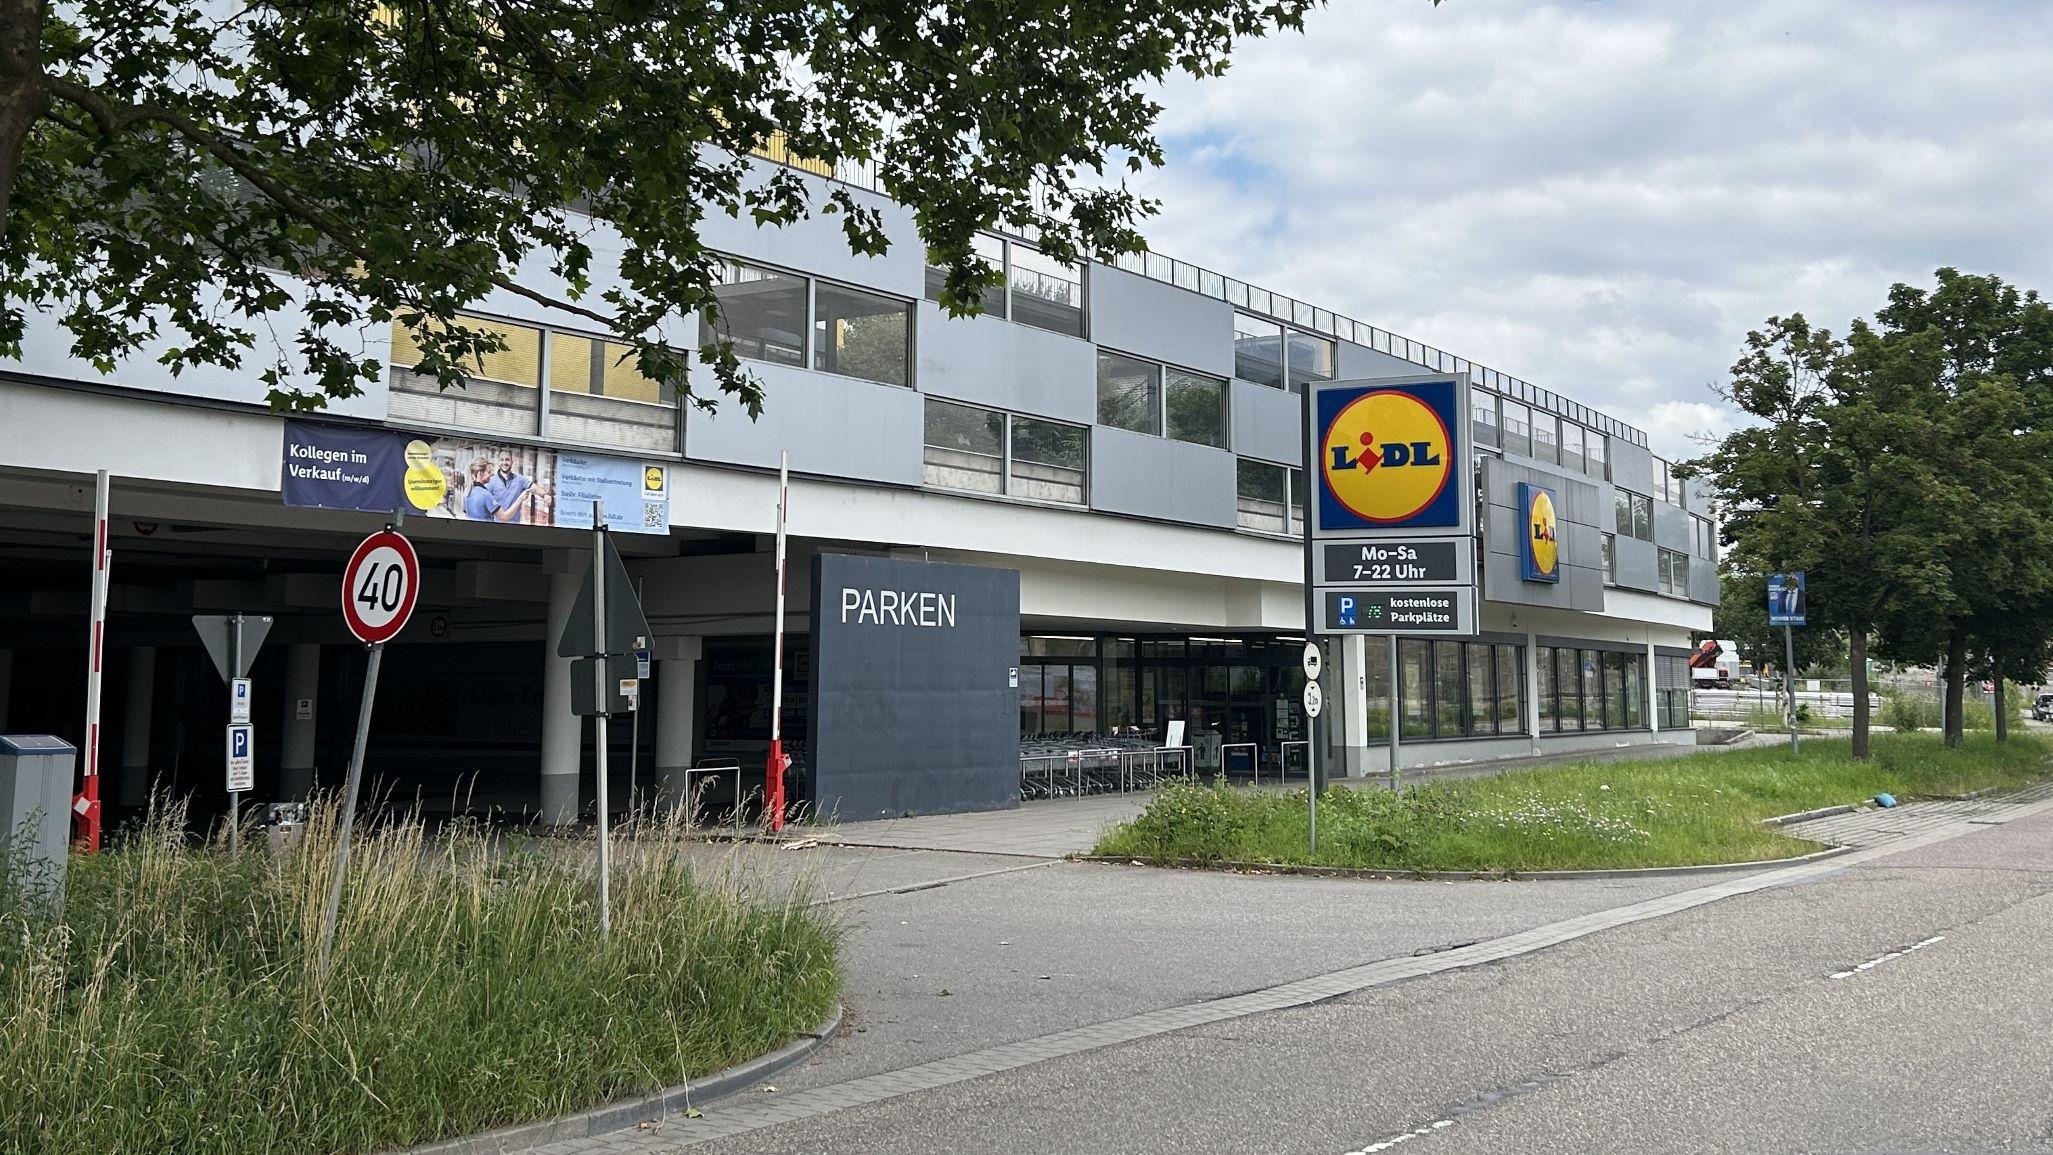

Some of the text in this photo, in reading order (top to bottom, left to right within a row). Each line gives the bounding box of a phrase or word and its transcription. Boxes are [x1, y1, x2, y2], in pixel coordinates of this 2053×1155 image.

[289, 443, 367, 465] Kollegen im
[1331, 432, 1440, 475] LIDL
[289, 464, 370, 485] Verkauf (m/w/d)
[1395, 564, 1427, 579] Uhr
[358, 562, 403, 612] 40
[842, 588, 956, 627] PARKEN
[1390, 597, 1450, 608] kostenlose
[1391, 612, 1450, 625] Parkplätze
